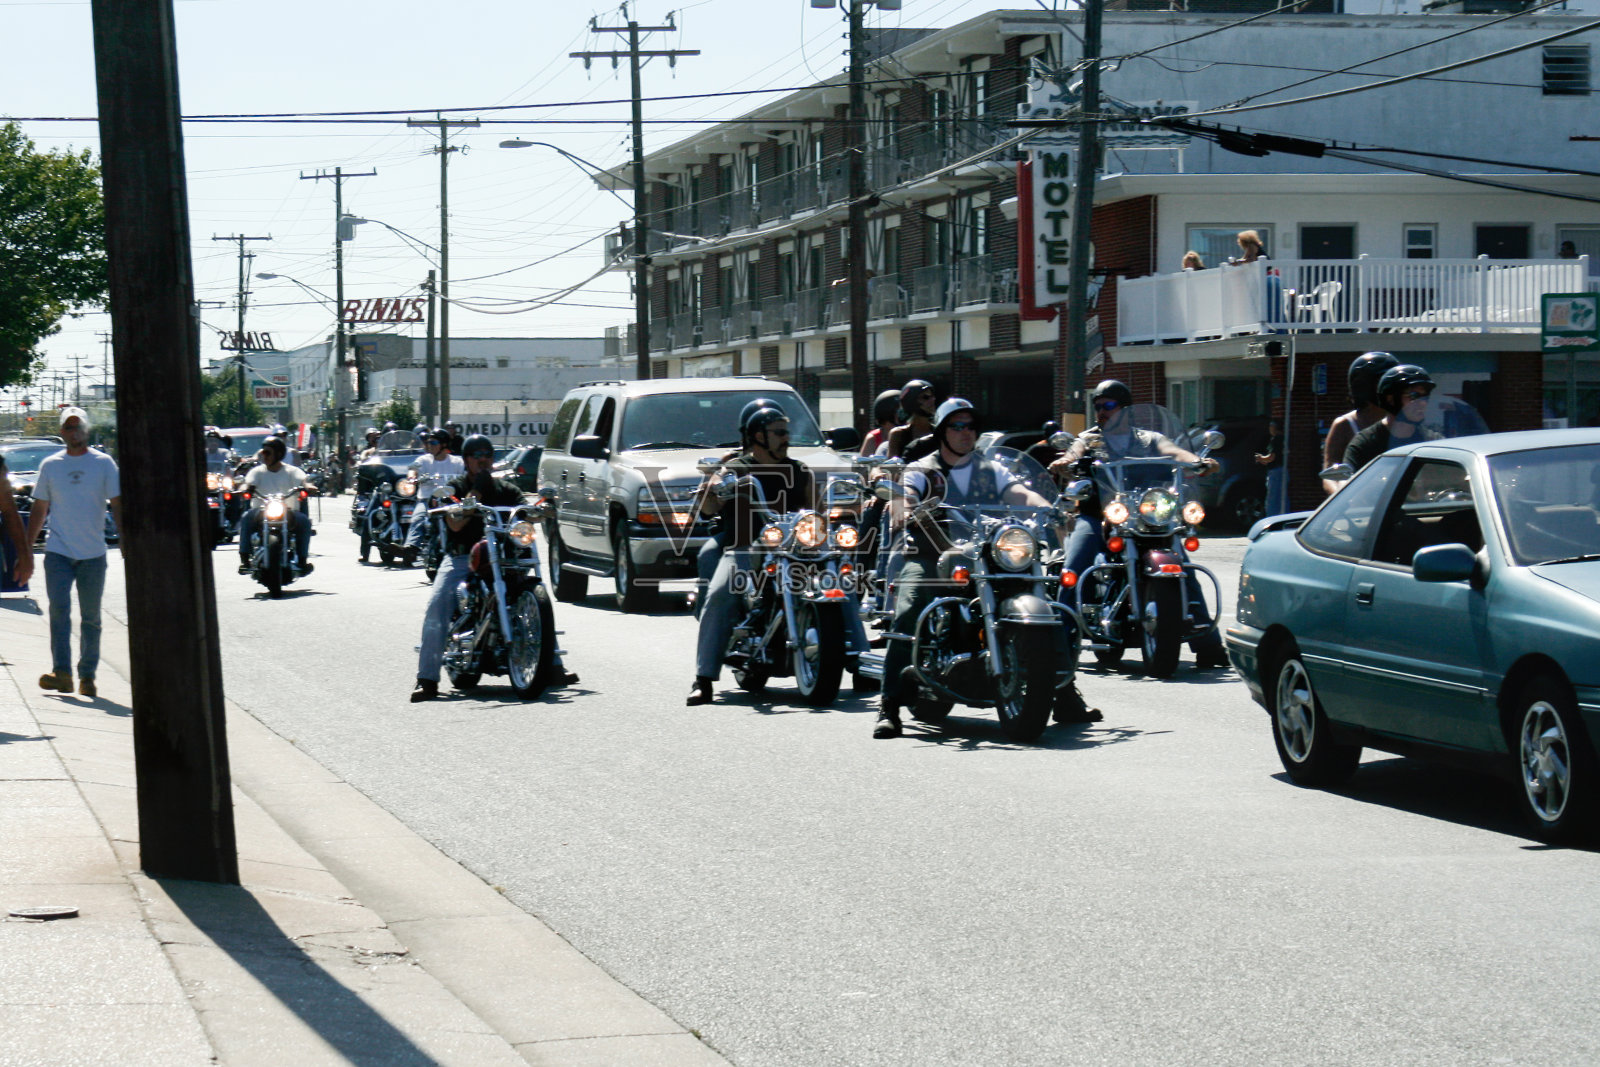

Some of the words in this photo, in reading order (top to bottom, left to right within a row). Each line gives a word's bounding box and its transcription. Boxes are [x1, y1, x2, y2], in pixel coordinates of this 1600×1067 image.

[1043, 152, 1070, 294] MOTEL
[342, 298, 427, 321] BINNS
[255, 387, 287, 398] BINNS
[455, 423, 511, 436] OMEDY
[519, 423, 548, 435] CLU
